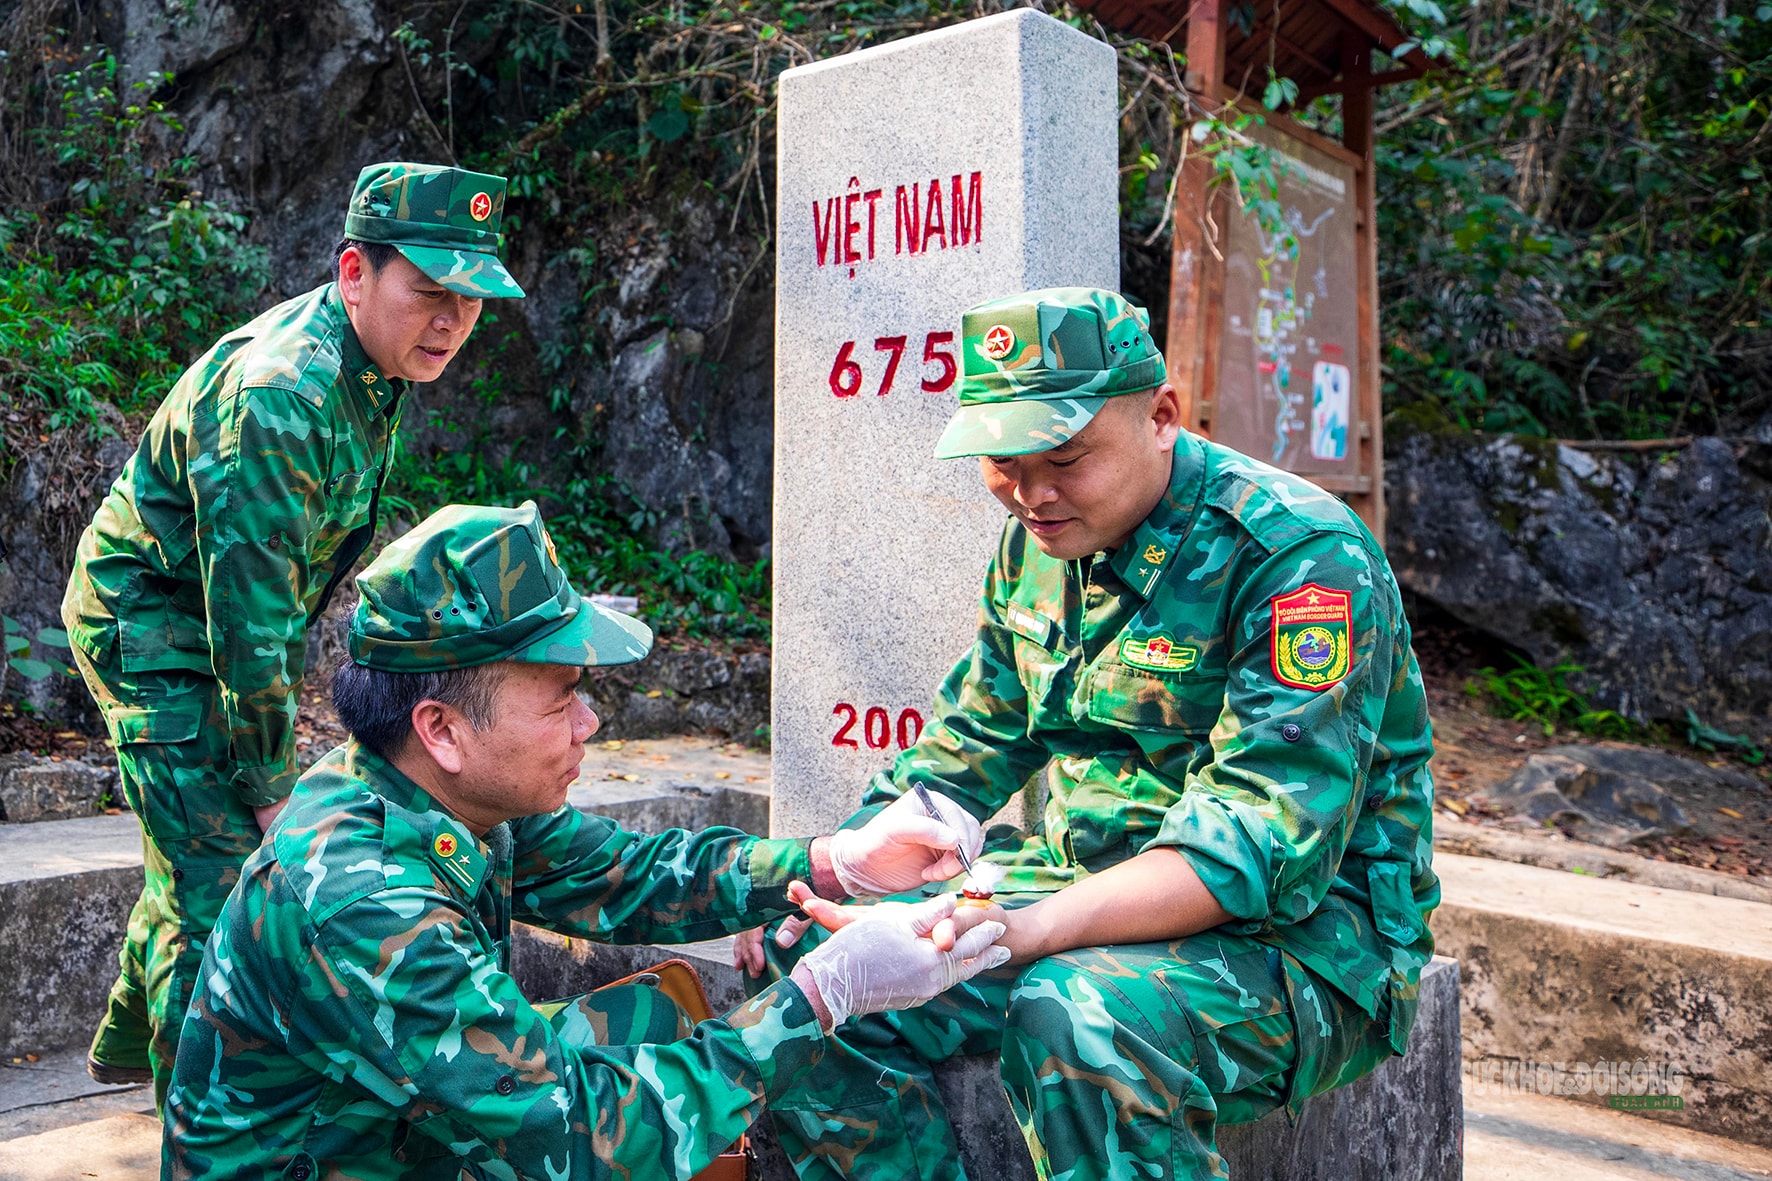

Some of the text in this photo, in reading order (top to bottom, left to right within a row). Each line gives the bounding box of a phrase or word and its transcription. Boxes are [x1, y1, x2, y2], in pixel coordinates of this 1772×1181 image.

[812, 171, 982, 280] VIỆT NAM
[828, 331, 957, 400] 675
